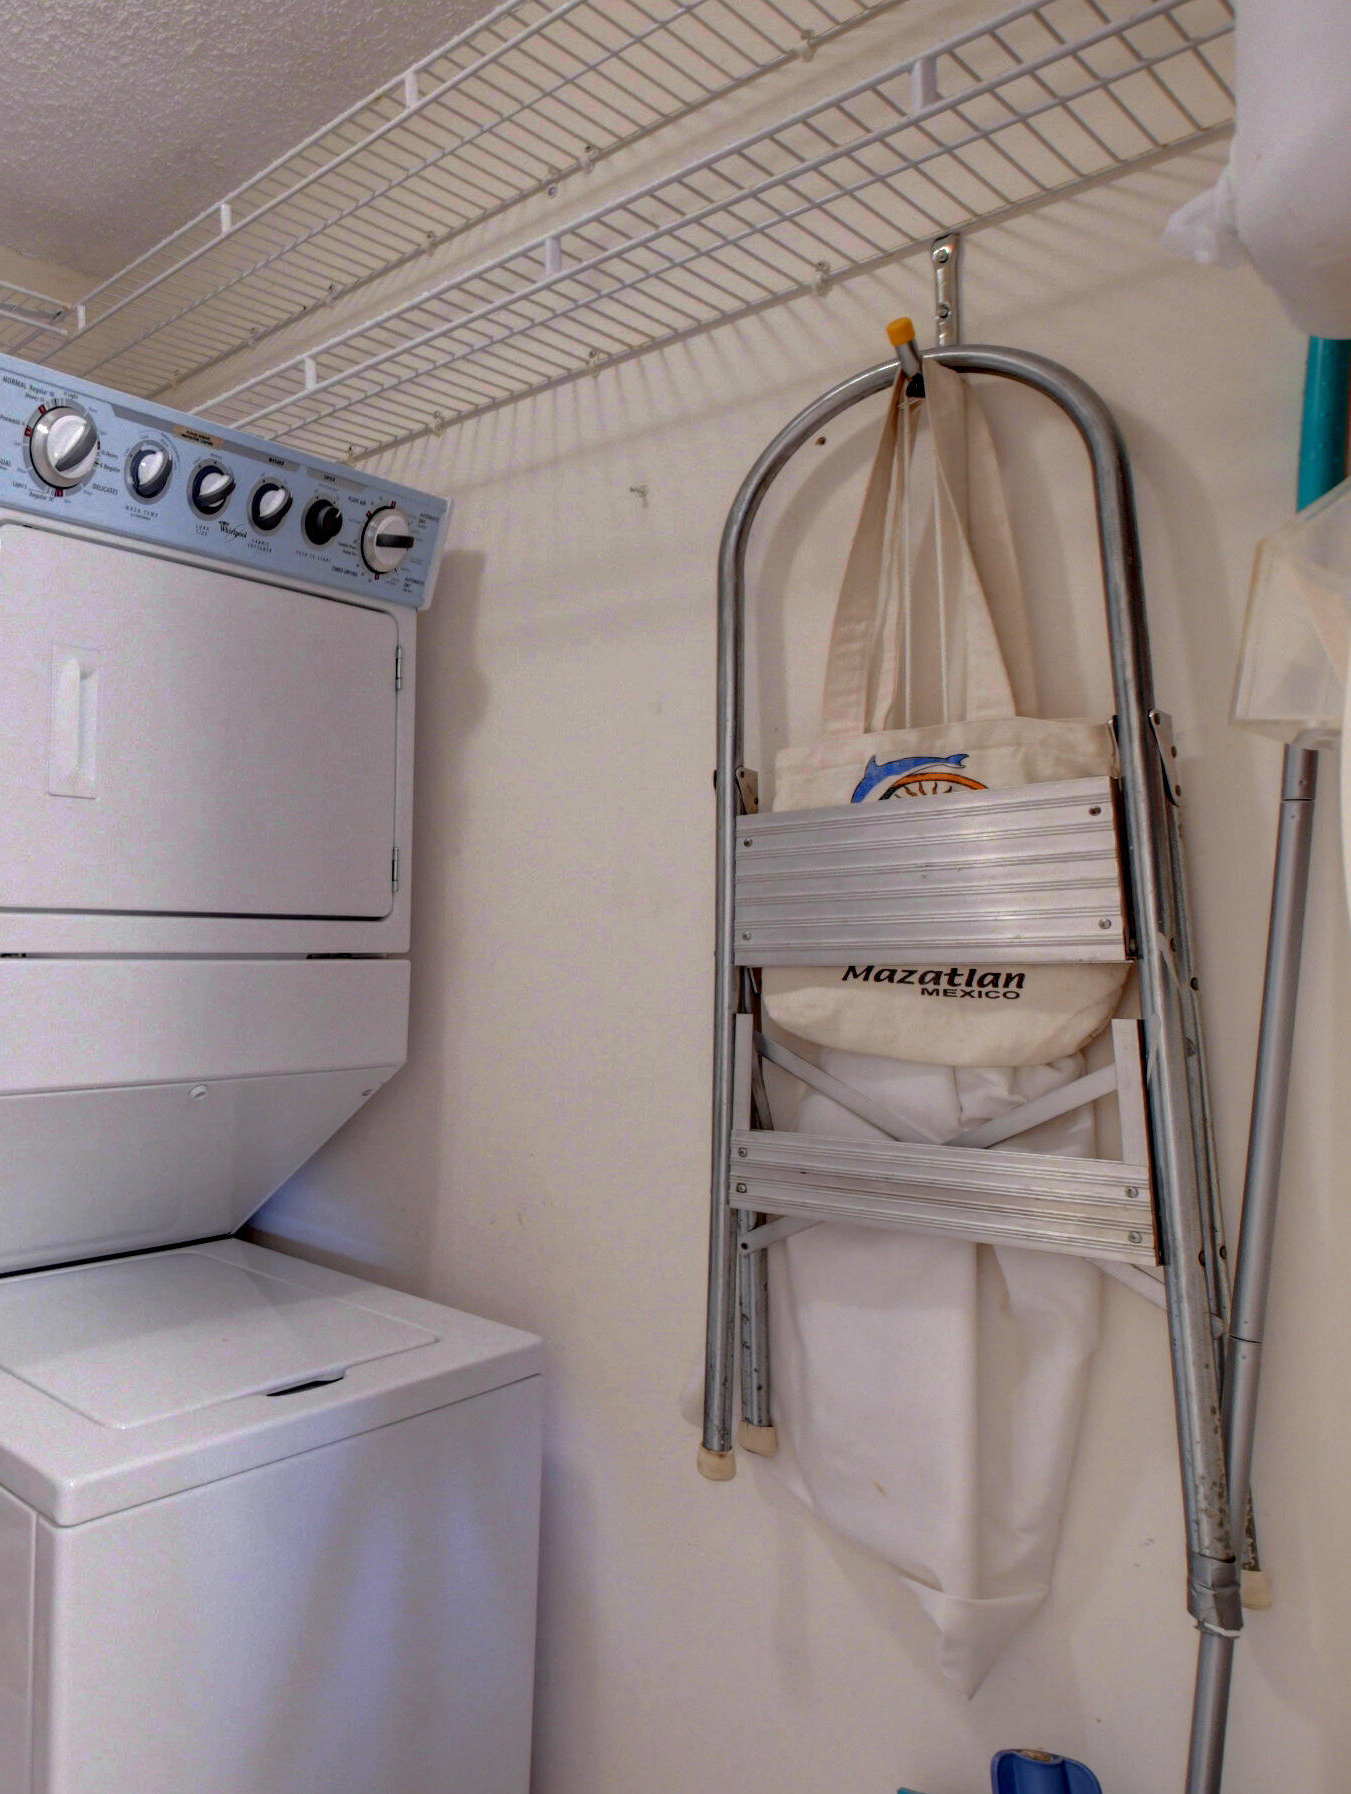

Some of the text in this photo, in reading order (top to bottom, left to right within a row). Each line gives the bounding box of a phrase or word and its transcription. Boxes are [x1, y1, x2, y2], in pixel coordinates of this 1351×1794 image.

[220, 524, 248, 539] Whirlpool
[842, 965, 1026, 989] Mazatlan
[920, 987, 1020, 1000] MEXICO
